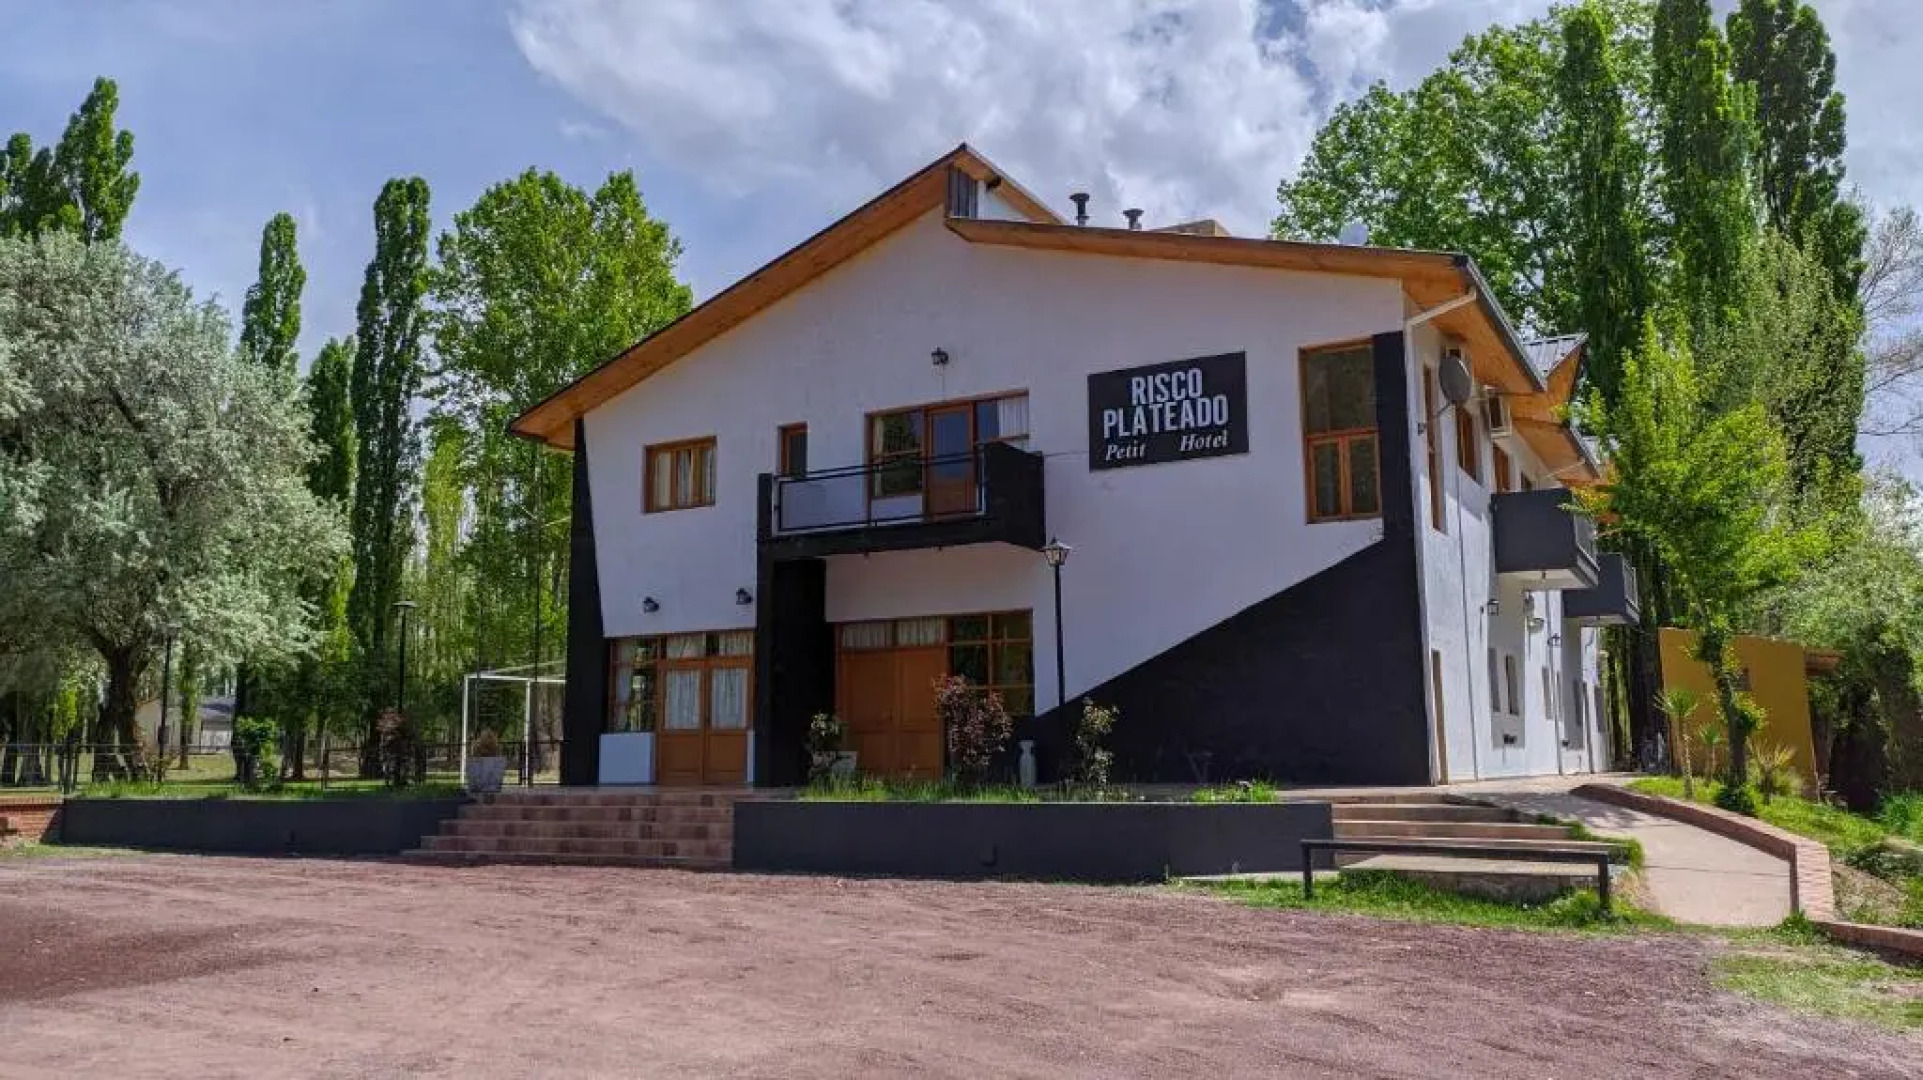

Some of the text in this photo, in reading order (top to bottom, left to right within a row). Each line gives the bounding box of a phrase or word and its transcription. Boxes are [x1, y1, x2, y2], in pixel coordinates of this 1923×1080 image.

[1131, 368, 1203, 405] RISCO
[1103, 394, 1229, 439] PLATEADO
[1105, 430, 1228, 461] Petit Hotel
